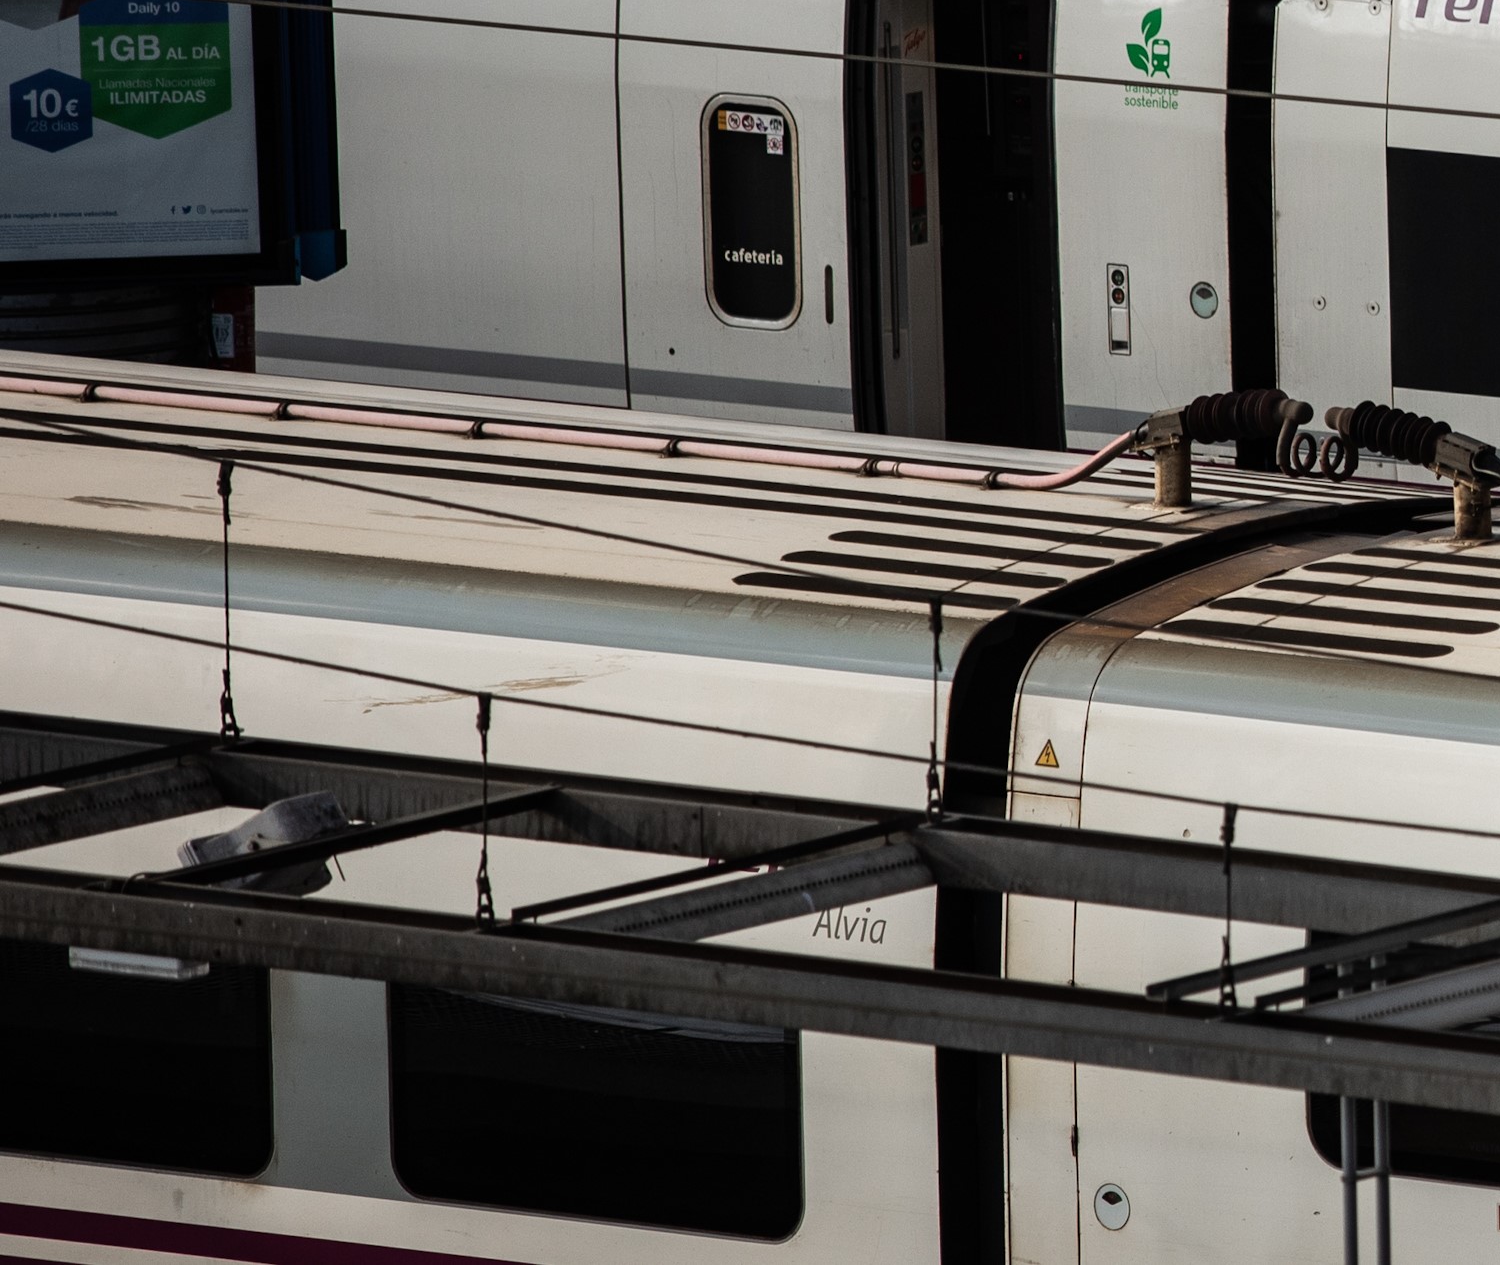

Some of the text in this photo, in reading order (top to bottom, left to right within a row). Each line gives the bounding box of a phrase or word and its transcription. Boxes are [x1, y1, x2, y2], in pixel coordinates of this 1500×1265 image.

[128, 1, 180, 15] Daily 10
[91, 34, 221, 62] 1GB AL DÍA
[99, 77, 216, 90] Llamadas Nacionales
[109, 90, 207, 105] ILIMITADAS
[1124, 95, 1178, 110] sostenible
[25, 119, 79, 133] /28 días
[725, 248, 783, 265] cafeteria
[812, 905, 887, 944] Alvia
